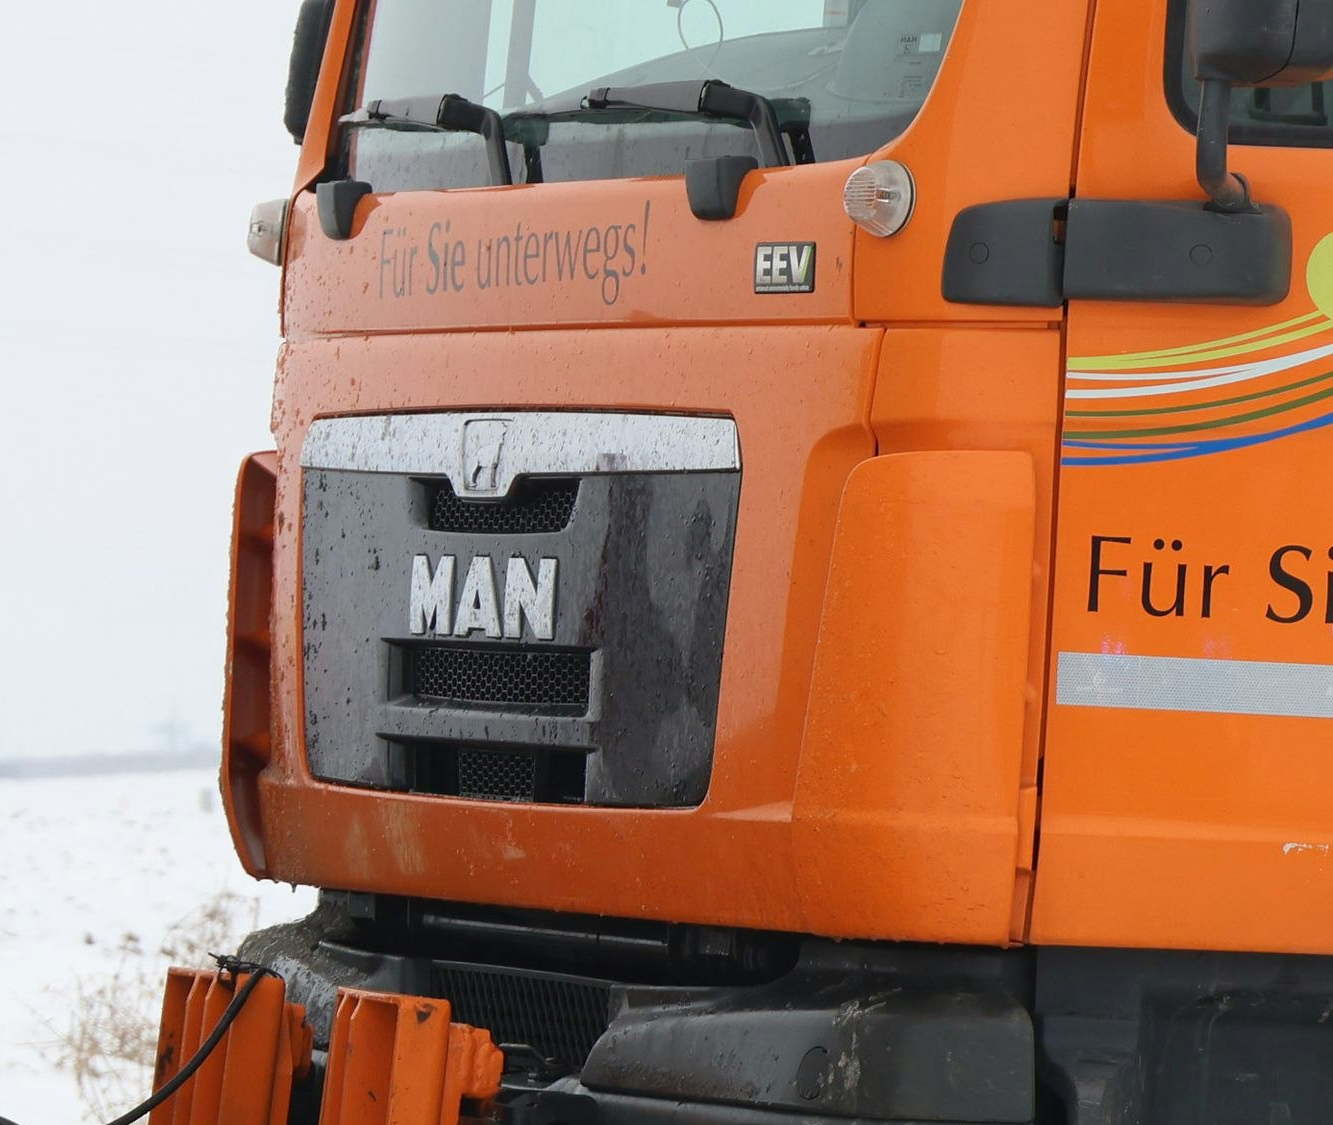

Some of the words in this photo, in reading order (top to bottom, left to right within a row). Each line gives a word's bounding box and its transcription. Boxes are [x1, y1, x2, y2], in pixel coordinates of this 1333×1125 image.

[378, 227, 418, 299] Für
[426, 218, 466, 295] Sie
[477, 200, 650, 305] unterwegs!
[756, 246, 812, 284] EEV
[410, 554, 558, 641] MAN
[1087, 535, 1230, 618] Für
